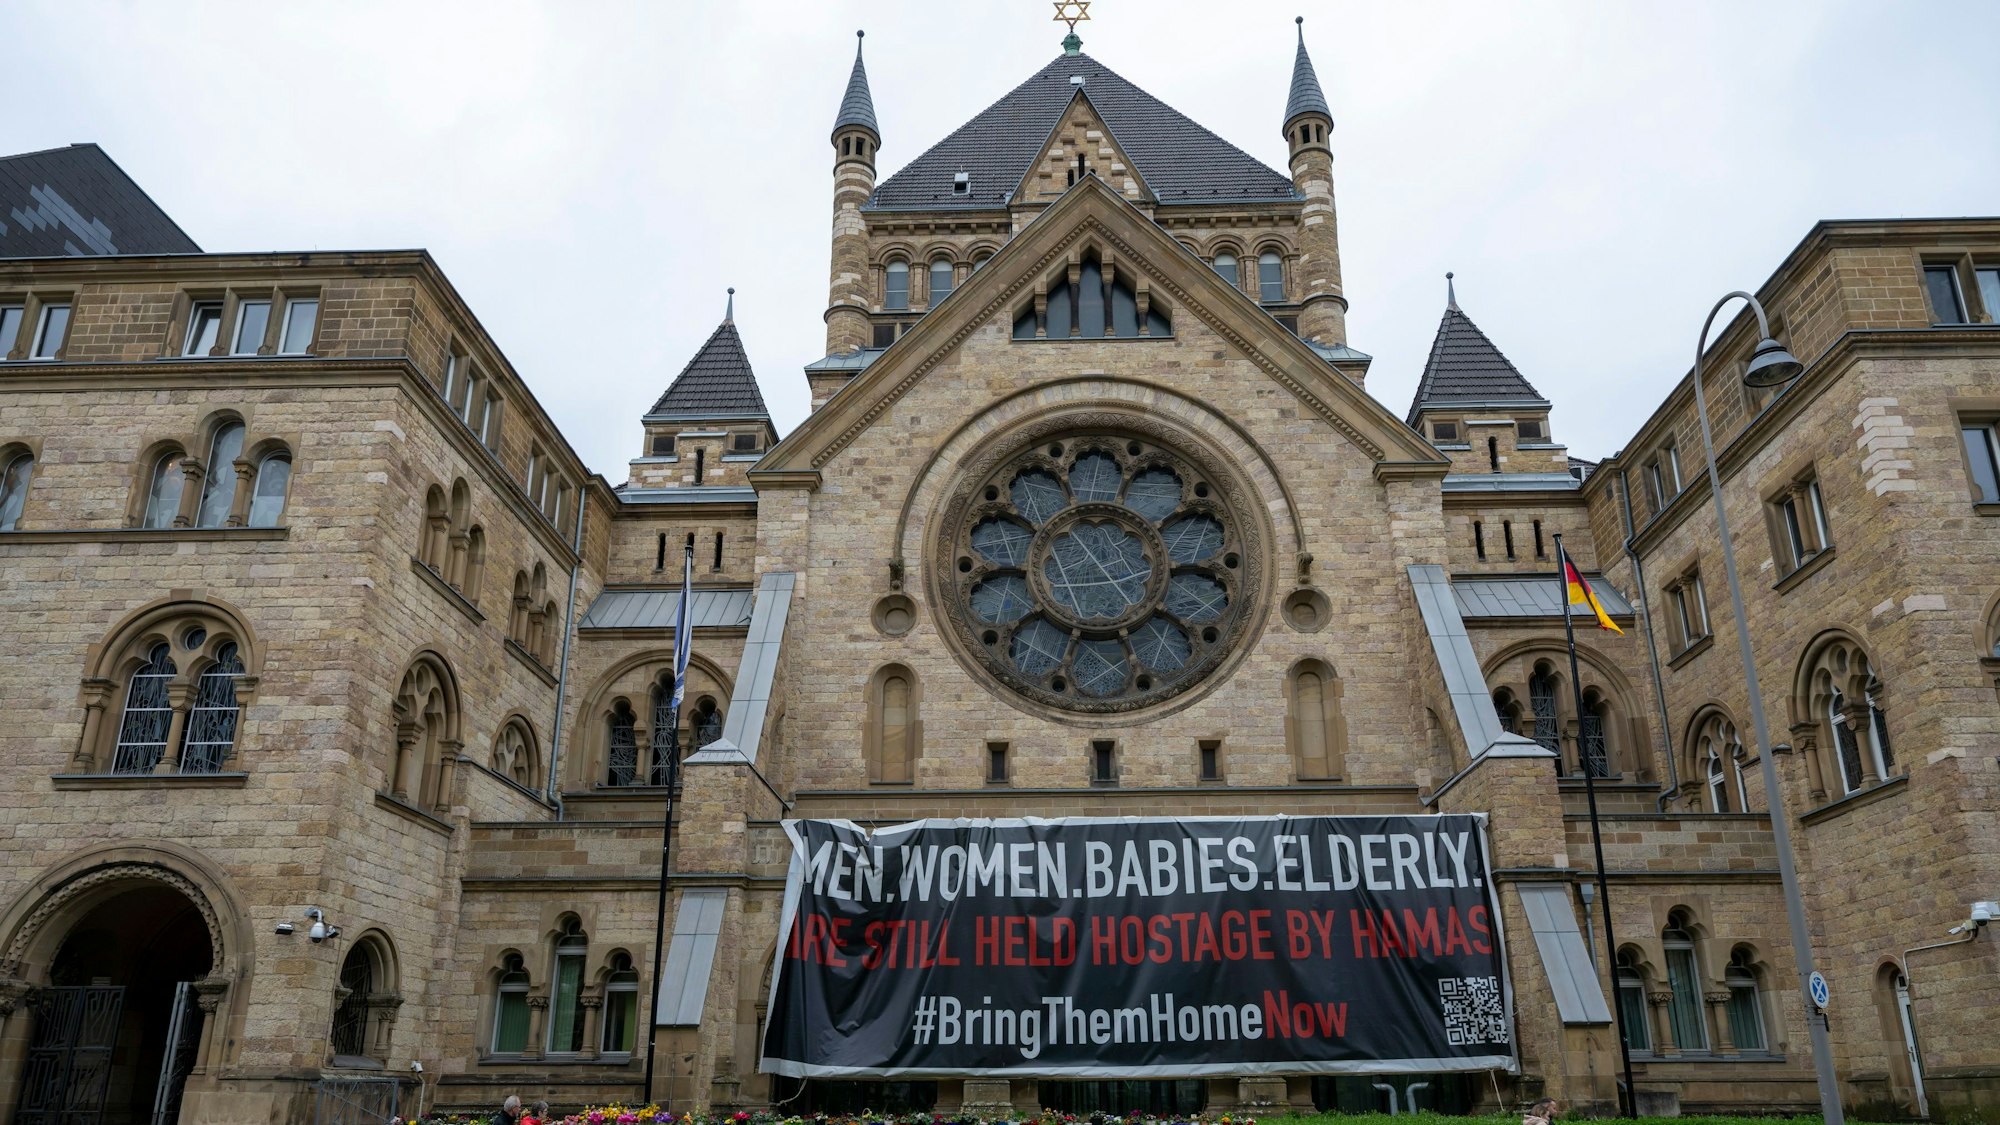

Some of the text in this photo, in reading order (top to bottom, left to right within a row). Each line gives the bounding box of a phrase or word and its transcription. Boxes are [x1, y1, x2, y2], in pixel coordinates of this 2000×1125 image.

[861, 918, 961, 970] STILL
[975, 915, 1077, 967] HELD
[1092, 909, 1275, 966] HOSTAGE
[1286, 909, 1335, 960] BY
[1350, 904, 1493, 958] HAMAS
[912, 989, 1348, 1060] #BringThemHomeNow
